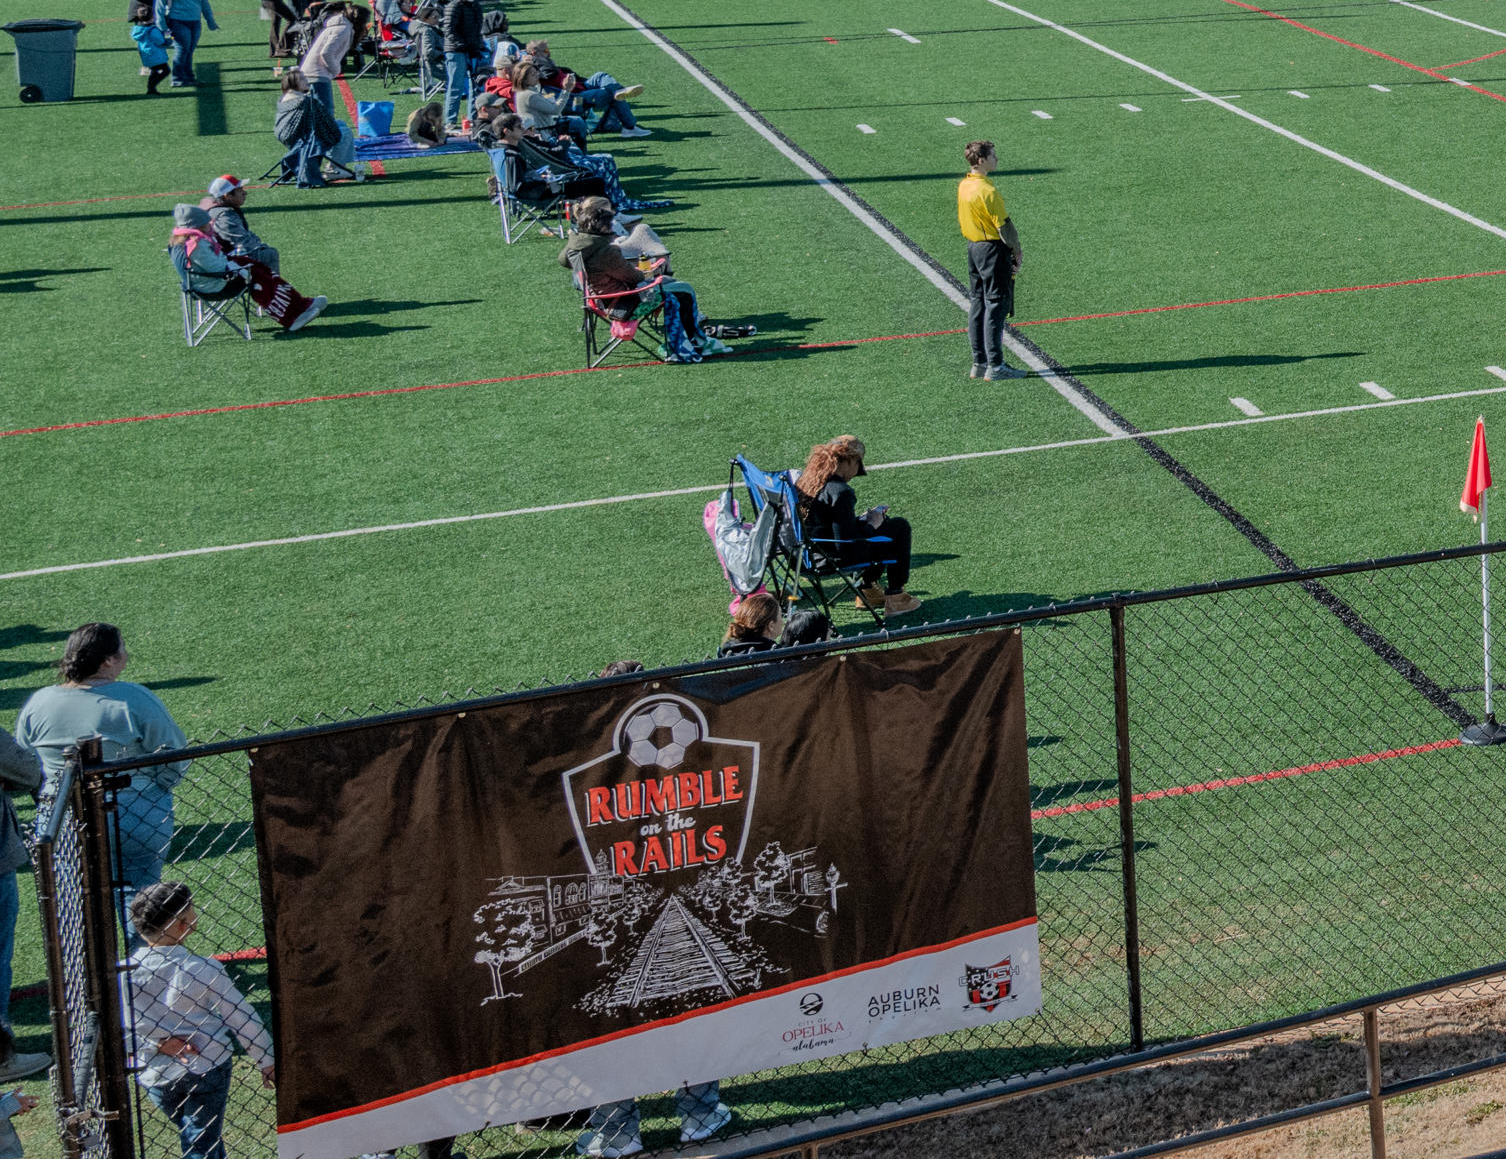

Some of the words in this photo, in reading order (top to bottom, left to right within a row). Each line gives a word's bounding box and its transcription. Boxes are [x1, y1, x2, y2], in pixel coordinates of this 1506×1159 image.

[586, 765, 743, 827] RUMBLE
[640, 821, 662, 836] on
[665, 813, 697, 831] the
[610, 825, 728, 878] RAILS
[959, 964, 1020, 987] CRUSH
[868, 984, 940, 1008] AUBURN
[868, 996, 941, 1017] OPELIKA
[782, 1021, 845, 1042] OPELIKA
